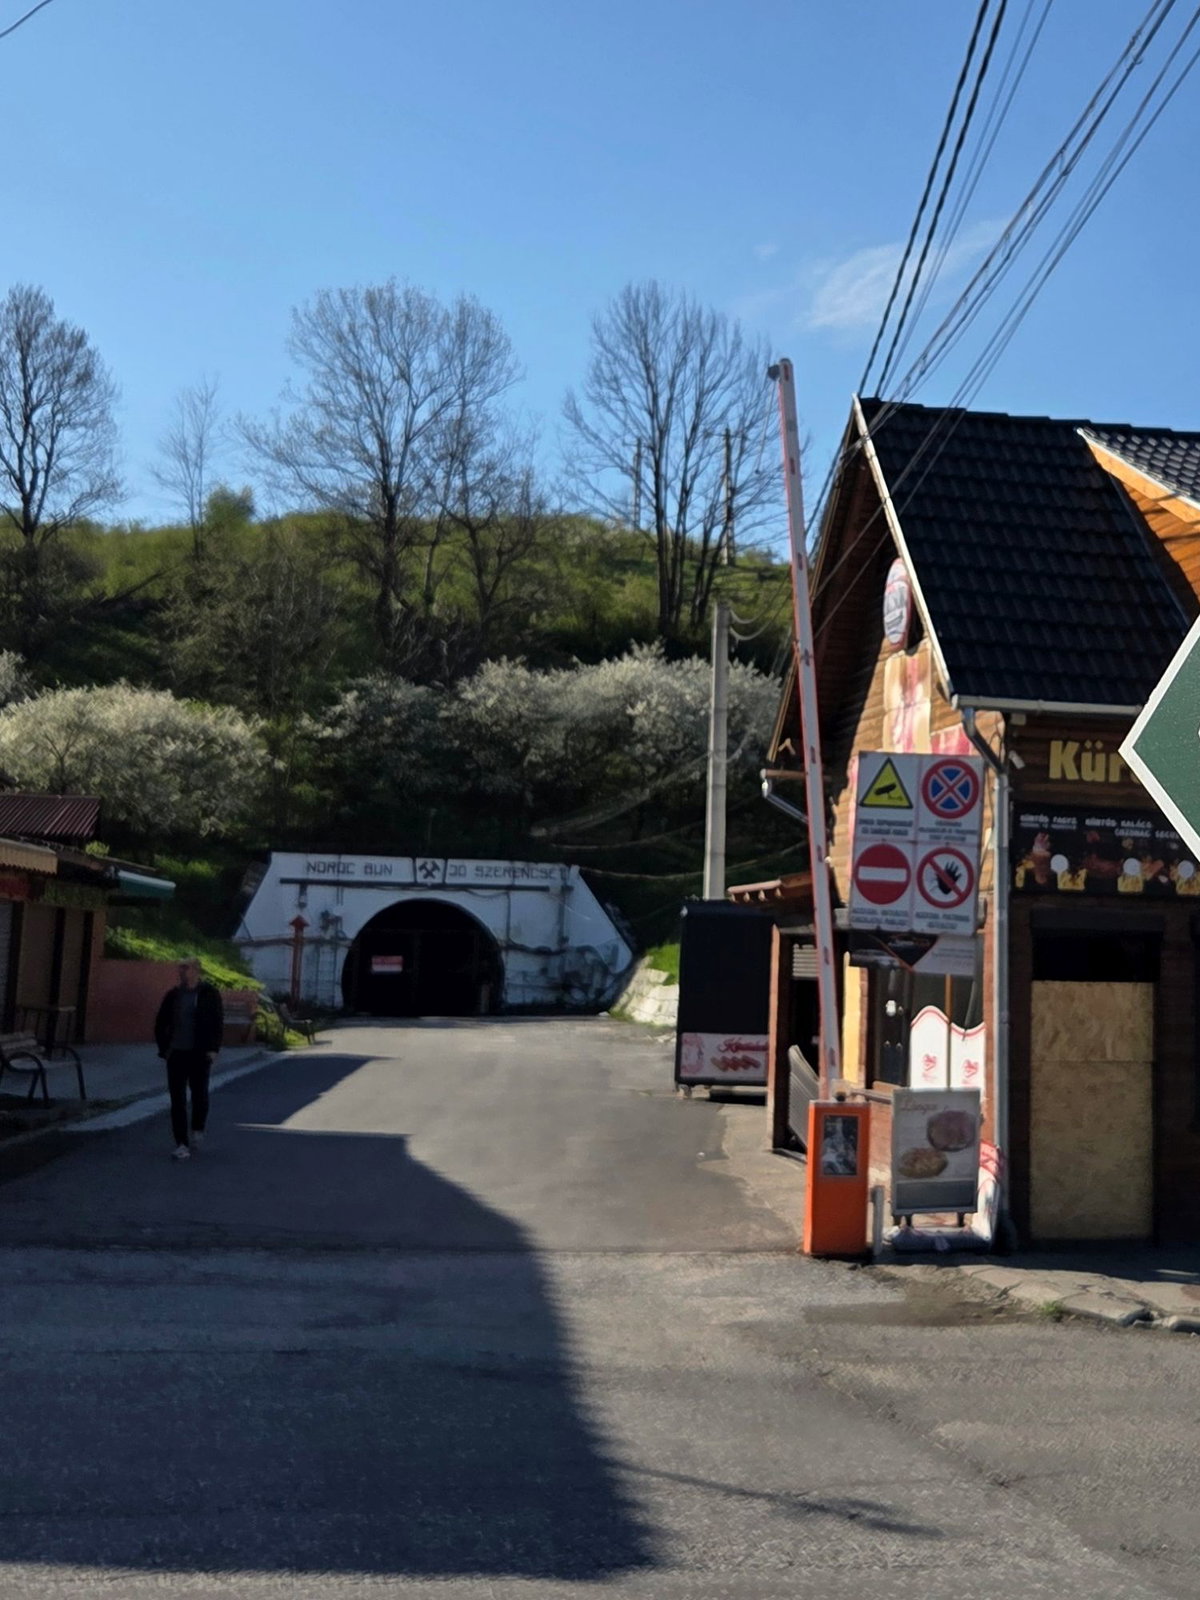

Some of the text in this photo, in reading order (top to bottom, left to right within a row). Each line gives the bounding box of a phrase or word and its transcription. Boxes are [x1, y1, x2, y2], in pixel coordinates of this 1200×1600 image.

[1049, 739, 1140, 784] Kür
[306, 861, 393, 876] NOROC BUN
